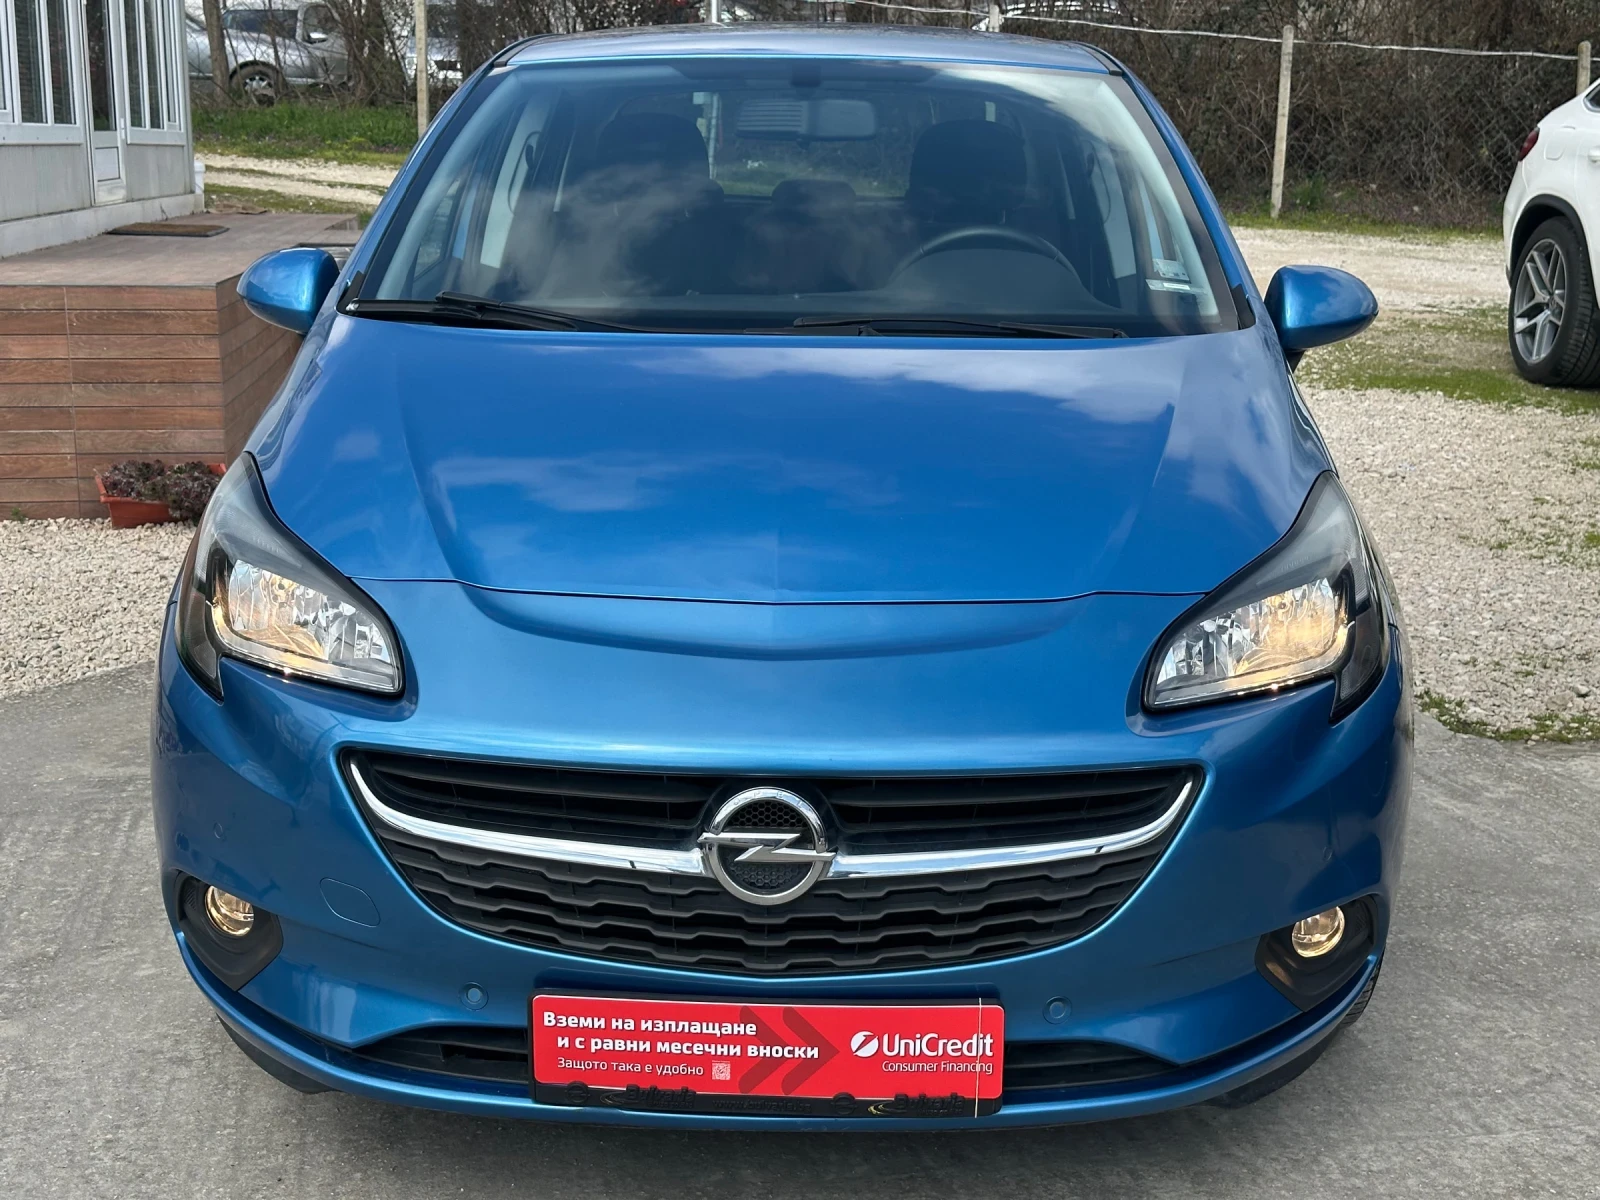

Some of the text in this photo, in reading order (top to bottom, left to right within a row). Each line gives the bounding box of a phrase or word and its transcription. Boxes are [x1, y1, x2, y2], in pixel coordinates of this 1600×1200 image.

[543, 1011, 757, 1037] Вземи на изплащане
[557, 1036, 819, 1059] и с равни месечни вноски
[882, 1032, 994, 1058] UniCredit
[557, 1057, 704, 1076] Защото така е удобно
[882, 1060, 993, 1075] Consumer Financing
